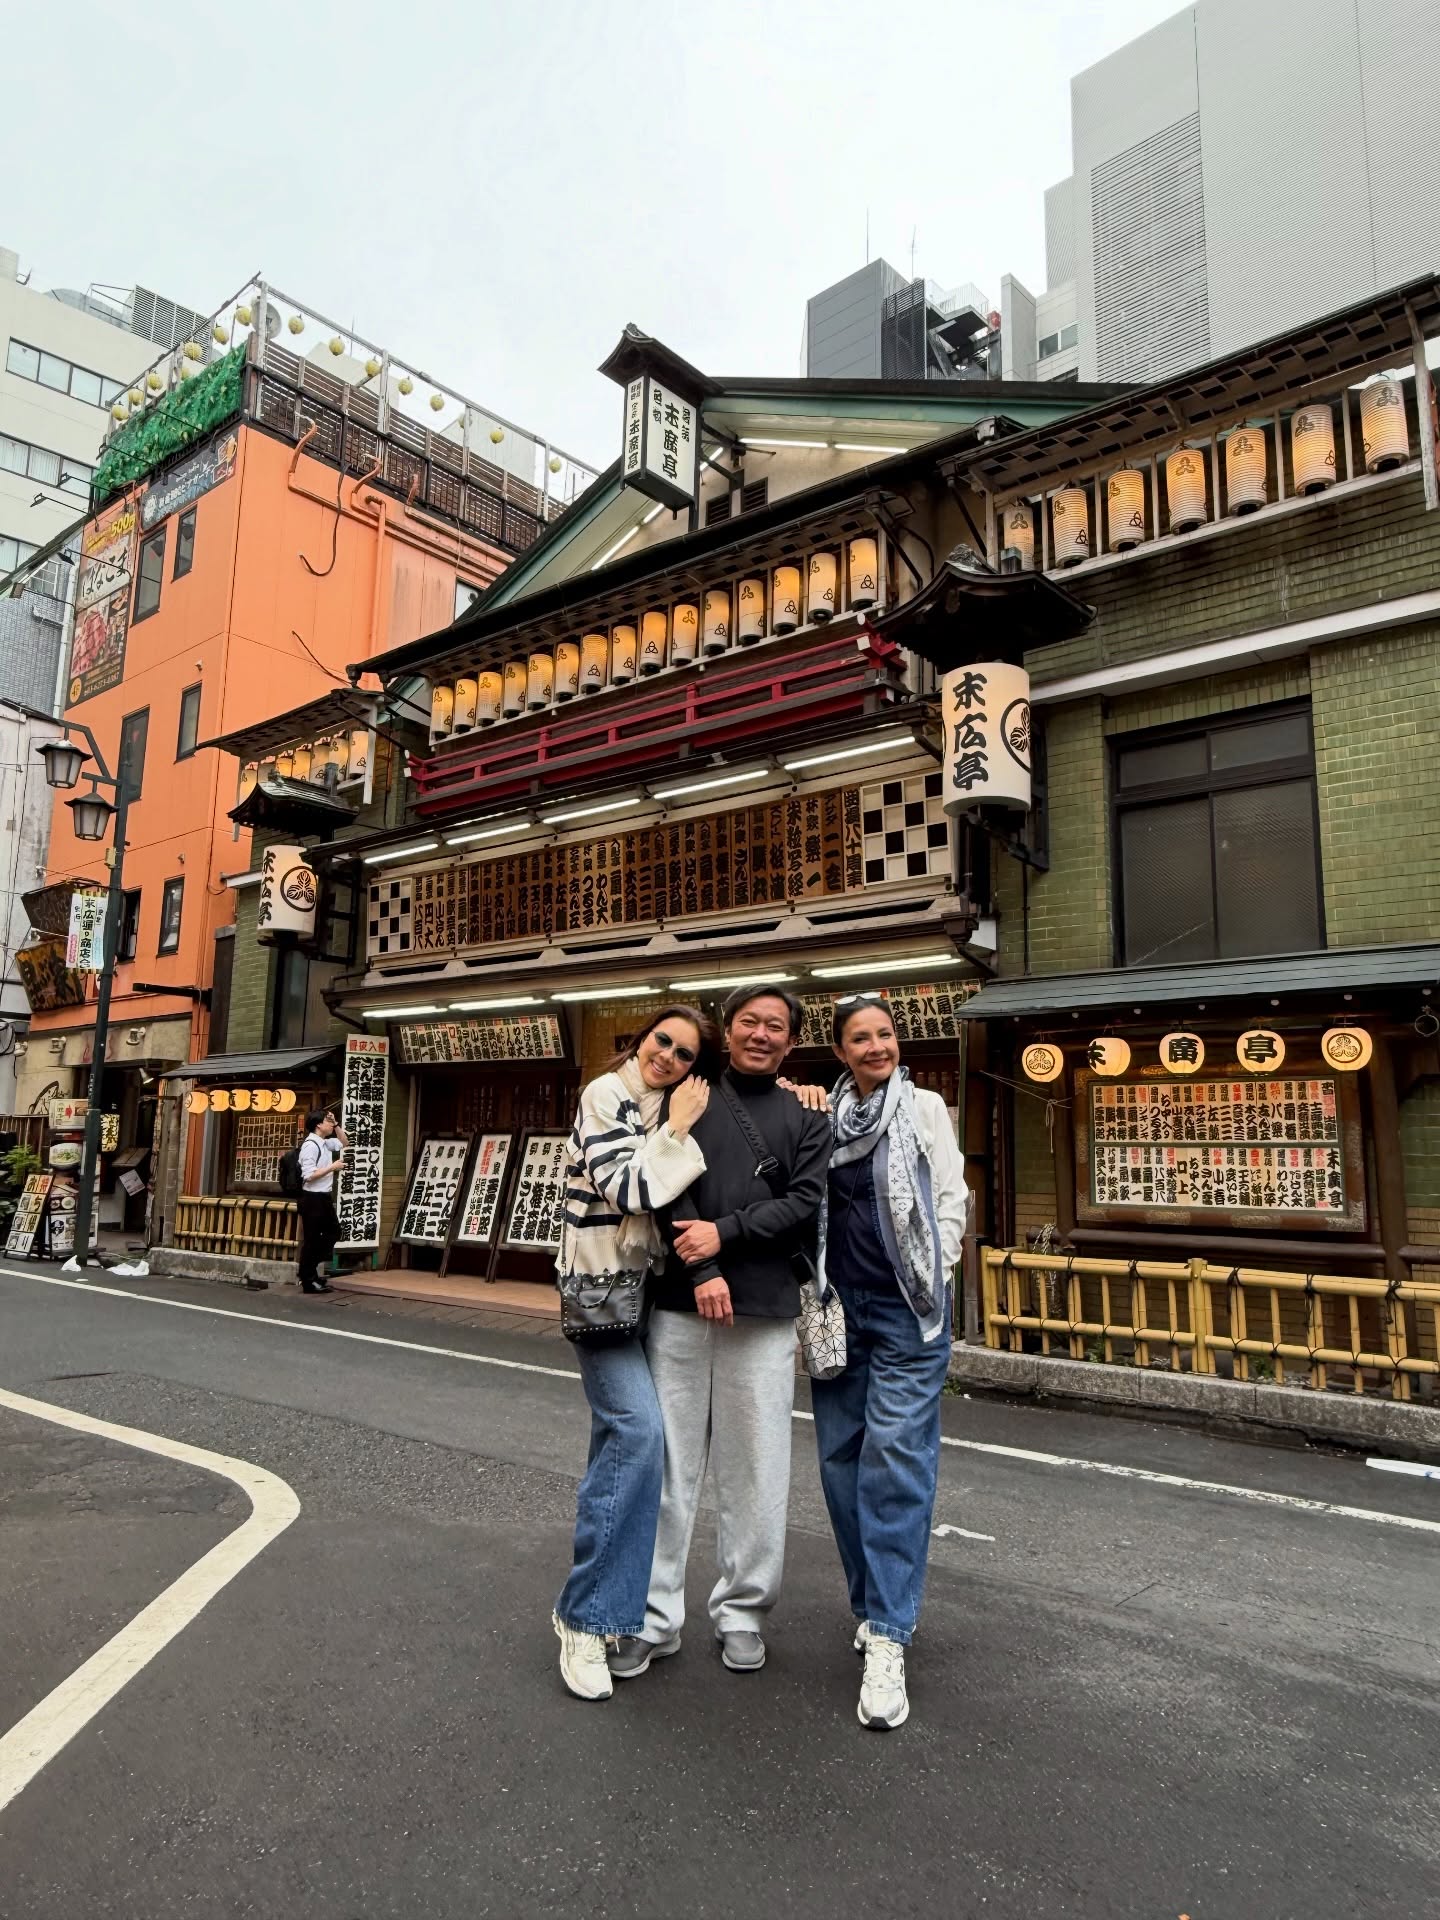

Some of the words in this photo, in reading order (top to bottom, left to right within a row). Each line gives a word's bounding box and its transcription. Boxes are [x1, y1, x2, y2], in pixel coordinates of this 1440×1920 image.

[662, 402, 679, 479] 末廣亭
[952, 671, 988, 790] 末広亭
[259, 851, 276, 925] 末広亭
[80, 898, 95, 968] 末広通り商店会
[350, 1040, 386, 1053] 昼夜入替
[1087, 1041, 1106, 1069] 末
[1169, 1037, 1198, 1064] 廣
[1244, 1034, 1278, 1062] 亭
[347, 1056, 361, 1100] 新真打
[360, 1057, 372, 1101] さん喬
[1139, 1106, 1148, 1139] ジキジキ
[1151, 1107, 1161, 1141] つる子
[1161, 1094, 1172, 1138] お中入り
[1208, 1105, 1219, 1140] 左龍
[1220, 1105, 1232, 1140] 三三
[1245, 1104, 1257, 1140] 木久蔵
[1258, 1103, 1270, 1140] 志ん五
[367, 1150, 379, 1193] しん平
[1155, 1167, 1165, 1202] 八百八
[1177, 1161, 1188, 1194] 口上
[1189, 1157, 1200, 1201] お中入り
[1264, 1169, 1276, 1206] しん平
[1277, 1170, 1289, 1207] わん丈
[1327, 1149, 1342, 1208] 末廣亭
[352, 1196, 365, 1241] 彦いち
[364, 1196, 378, 1240] 玉の輔
